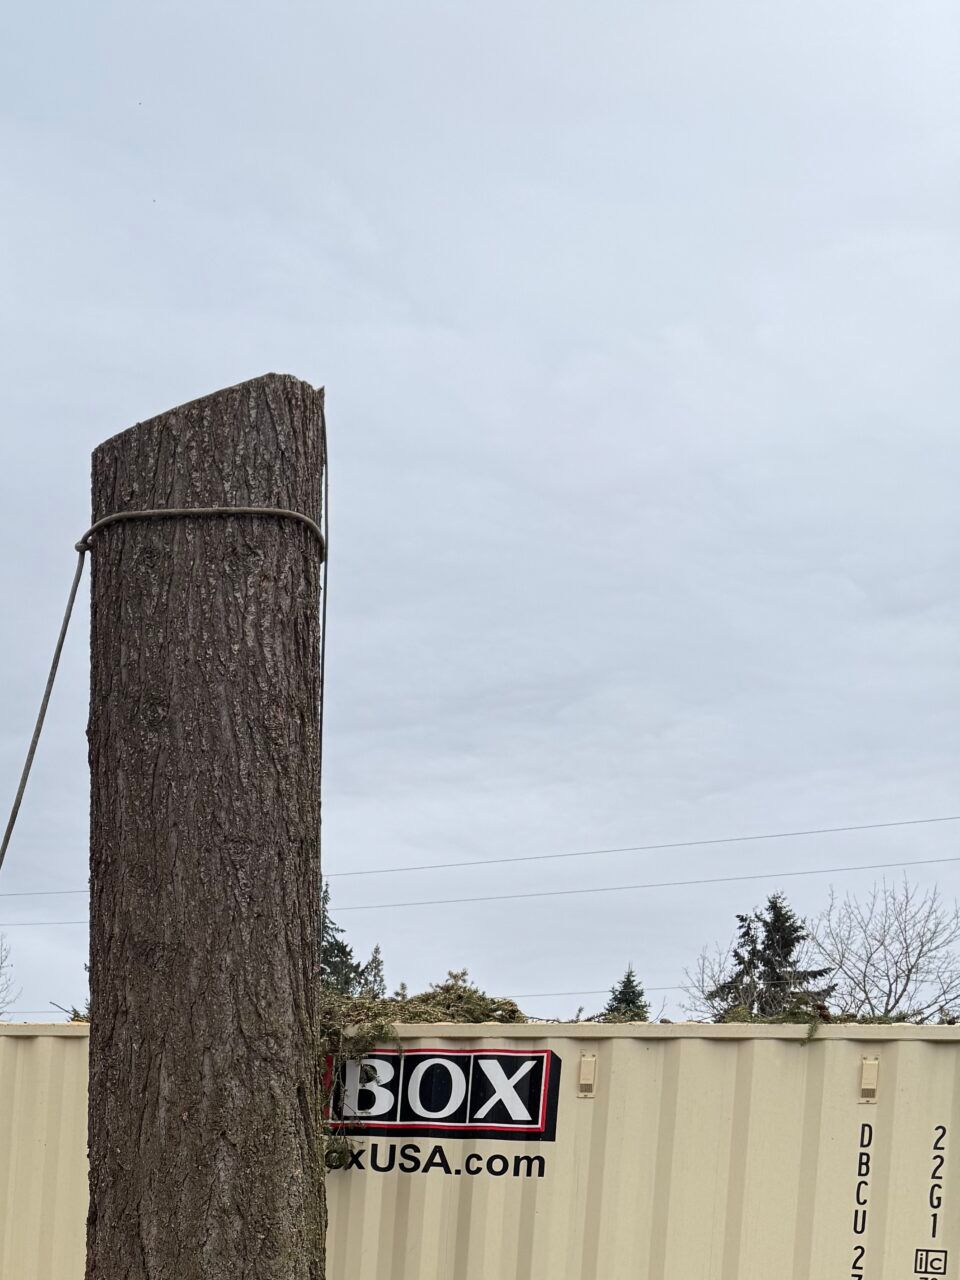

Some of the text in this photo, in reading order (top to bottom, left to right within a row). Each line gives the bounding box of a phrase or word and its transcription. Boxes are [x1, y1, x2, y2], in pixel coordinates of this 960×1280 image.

[342, 1057, 538, 1121] BOX
[853, 1123, 873, 1235] DBCU
[929, 1125, 947, 1239] 22G1
